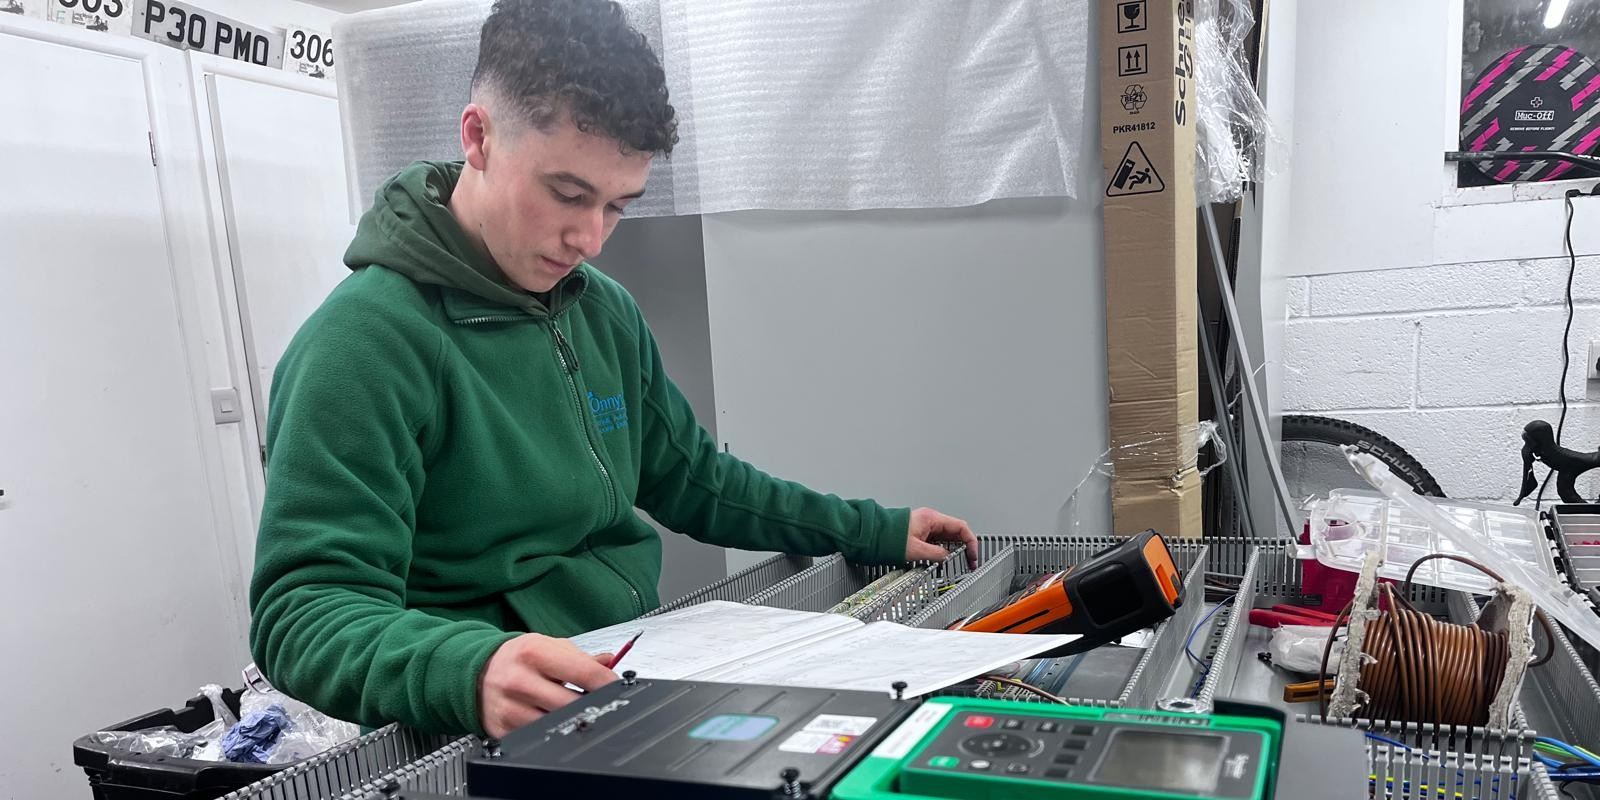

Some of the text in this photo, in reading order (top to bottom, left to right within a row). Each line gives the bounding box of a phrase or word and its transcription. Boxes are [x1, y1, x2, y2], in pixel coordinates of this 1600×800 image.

[145, 0, 206, 49] P30
[290, 30, 334, 67] 306
[1112, 122, 1156, 134] PKR41812
[1516, 112, 1552, 120] Muc-Off
